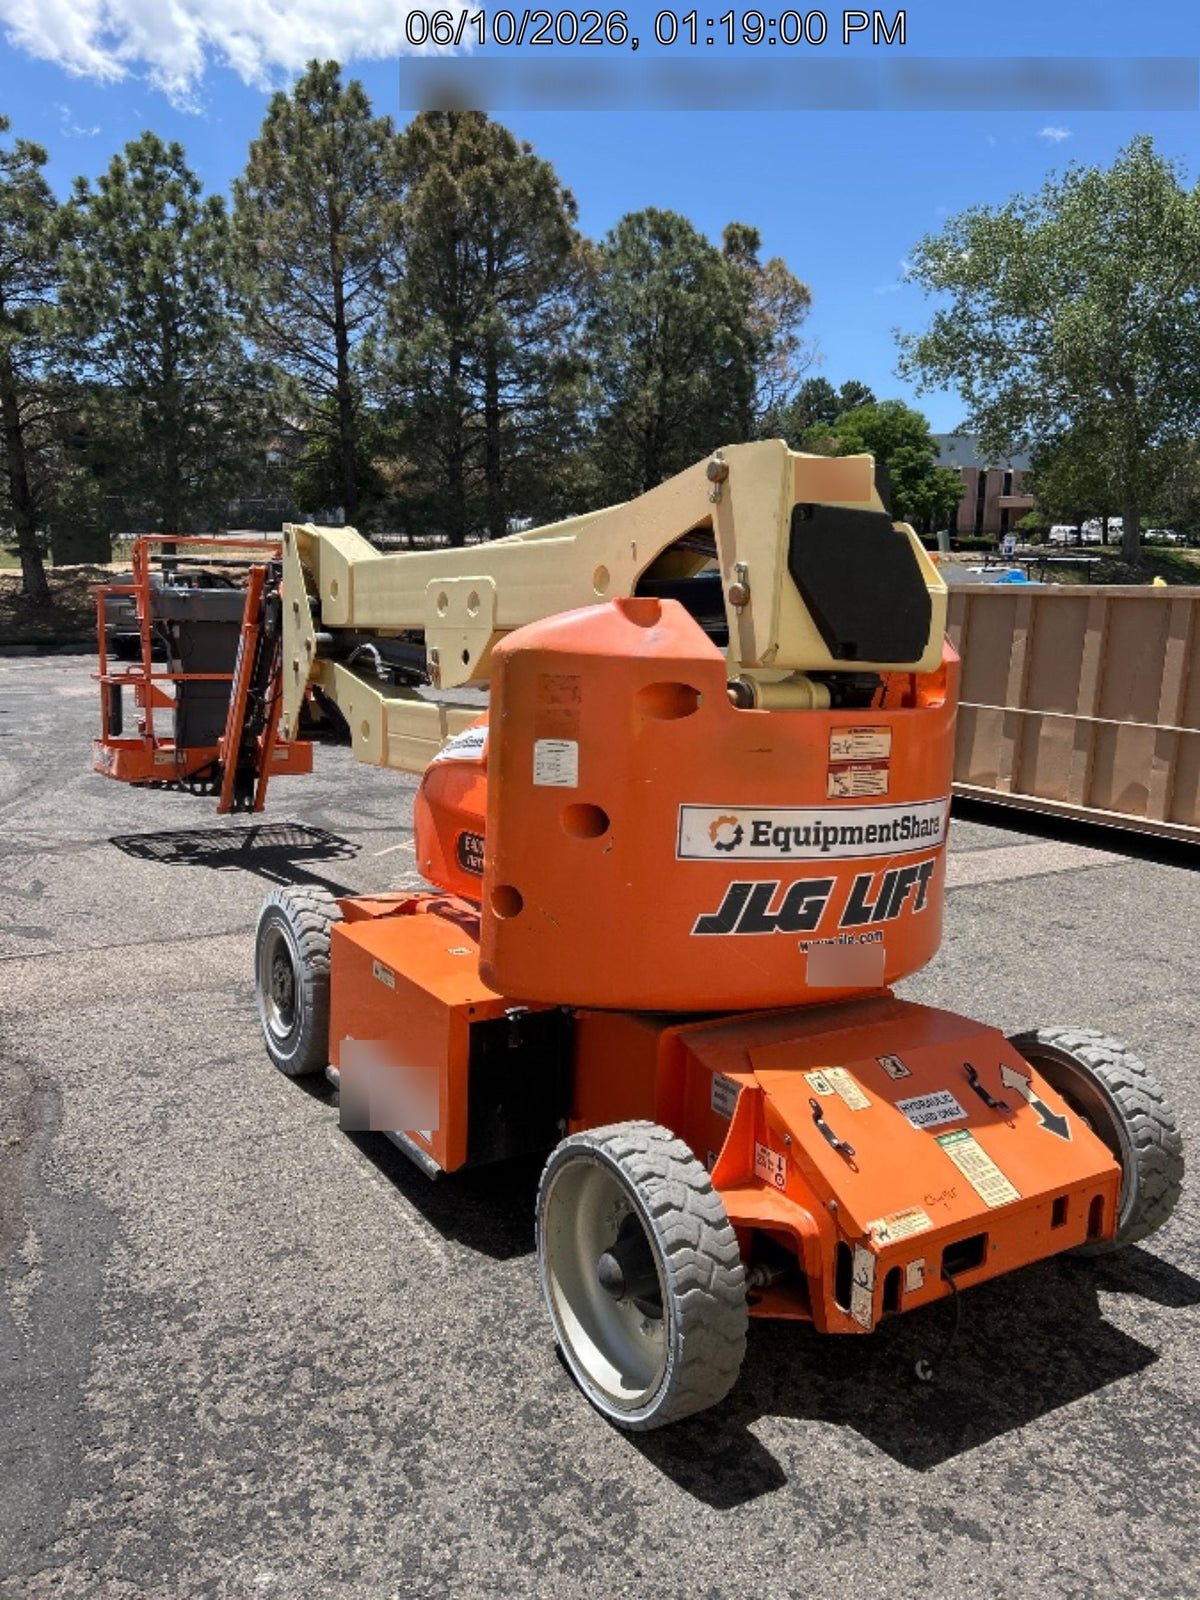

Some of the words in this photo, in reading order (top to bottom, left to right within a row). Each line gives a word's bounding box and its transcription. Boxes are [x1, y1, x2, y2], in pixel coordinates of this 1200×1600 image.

[750, 815, 940, 852] EquipmentShare
[691, 876, 838, 936] JLG
[838, 857, 936, 929] LIFT
[901, 1094, 954, 1113] HYDRAULIC
[910, 1112, 938, 1124] FLUID
[938, 1105, 961, 1119] ONLY
